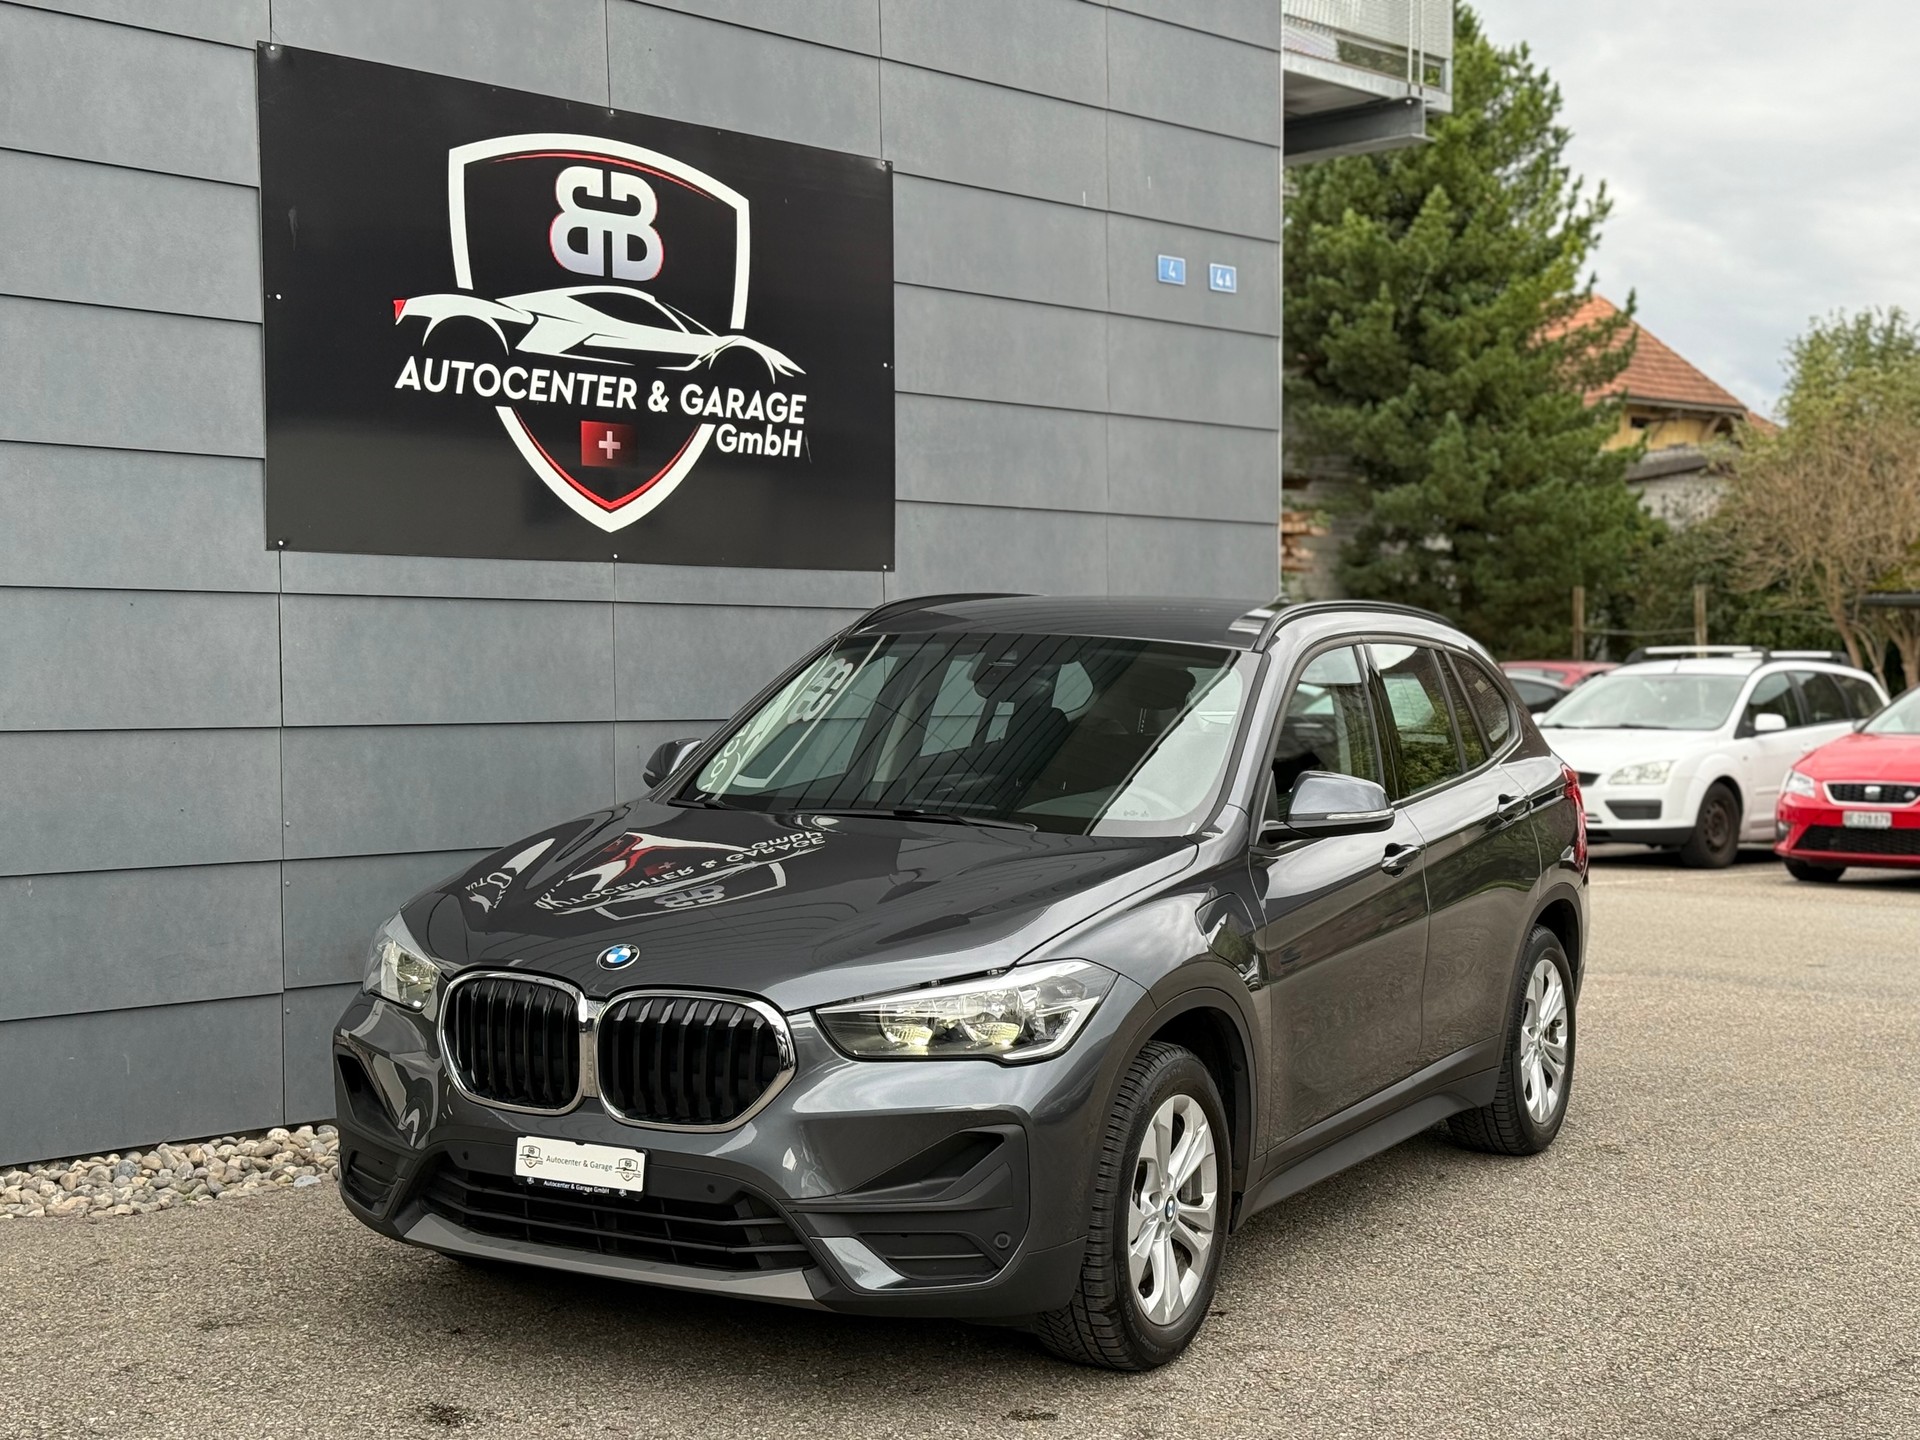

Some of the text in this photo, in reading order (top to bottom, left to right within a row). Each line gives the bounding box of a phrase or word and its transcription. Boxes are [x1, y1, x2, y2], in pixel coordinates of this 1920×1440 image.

[1168, 261, 1176, 278] 4
[394, 355, 807, 424] AUTOCENTER & GARAGE
[716, 423, 803, 457] GmbH
[545, 1155, 581, 1168] Autocenter
[582, 1159, 589, 1168] &
[589, 1161, 613, 1172] Garage
[543, 1180, 570, 1190] Autocenter
